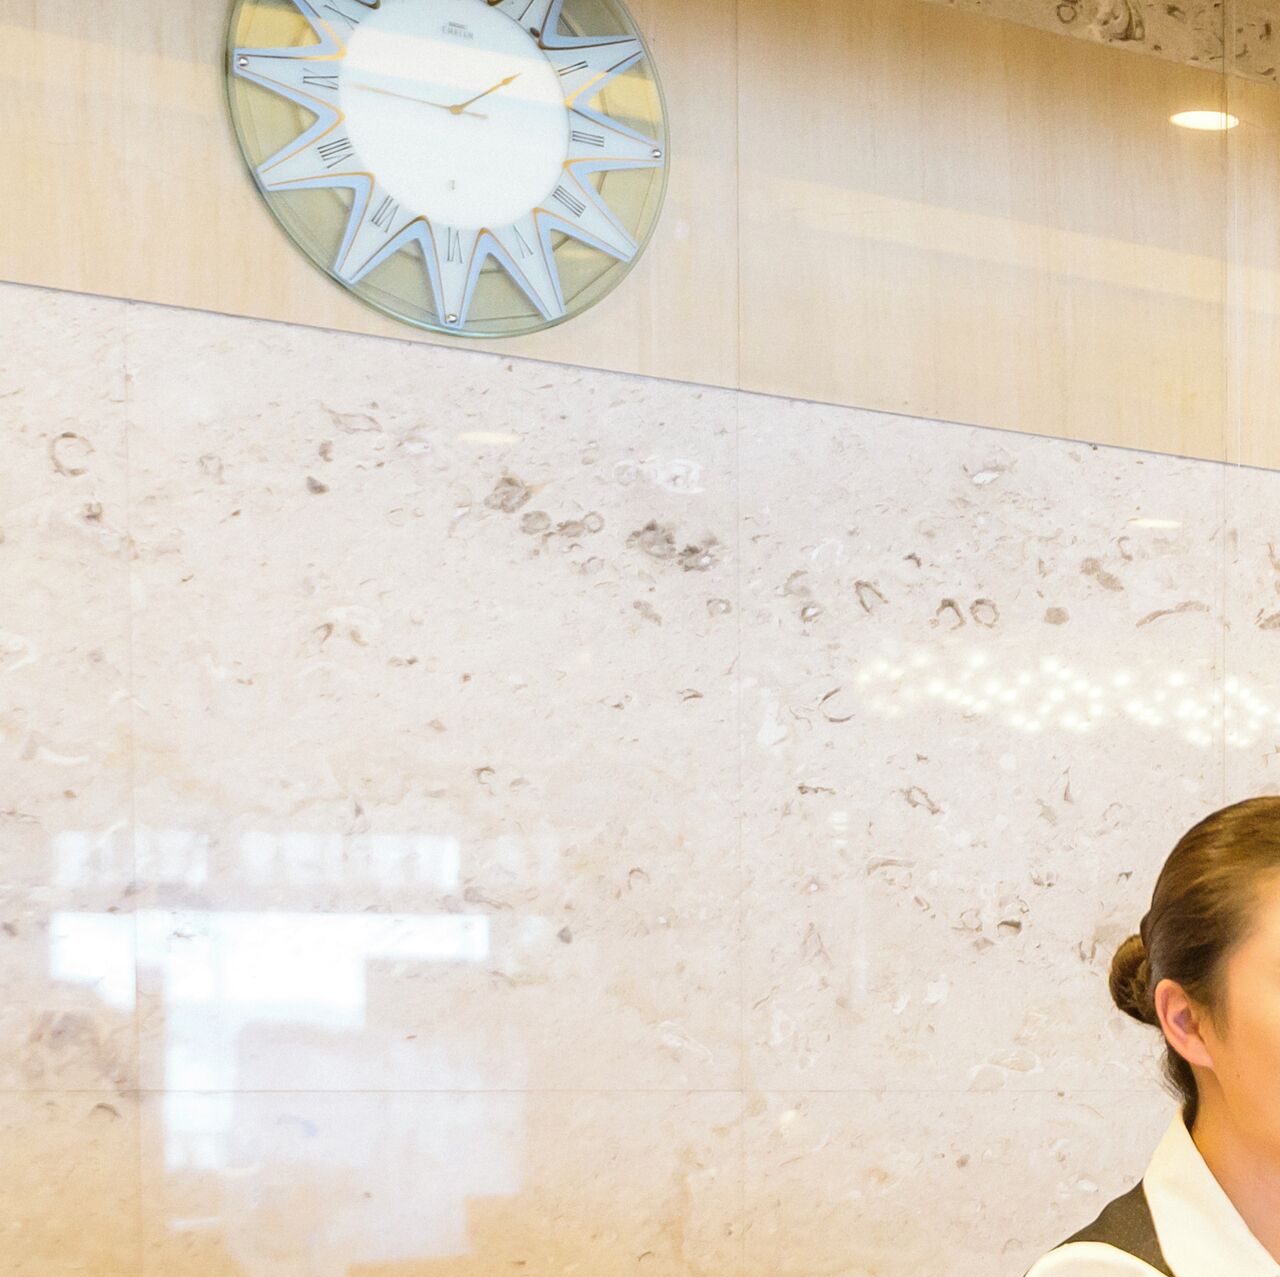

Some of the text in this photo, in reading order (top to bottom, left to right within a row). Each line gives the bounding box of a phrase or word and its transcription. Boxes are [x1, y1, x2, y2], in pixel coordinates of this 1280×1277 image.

[303, 68, 339, 90] IX
[558, 61, 589, 76] II
[317, 137, 354, 169] VIII
[572, 130, 604, 147] III
[371, 195, 399, 233] VII
[552, 185, 586, 217] IIII
[446, 227, 463, 264] VI
[513, 224, 533, 258] V
